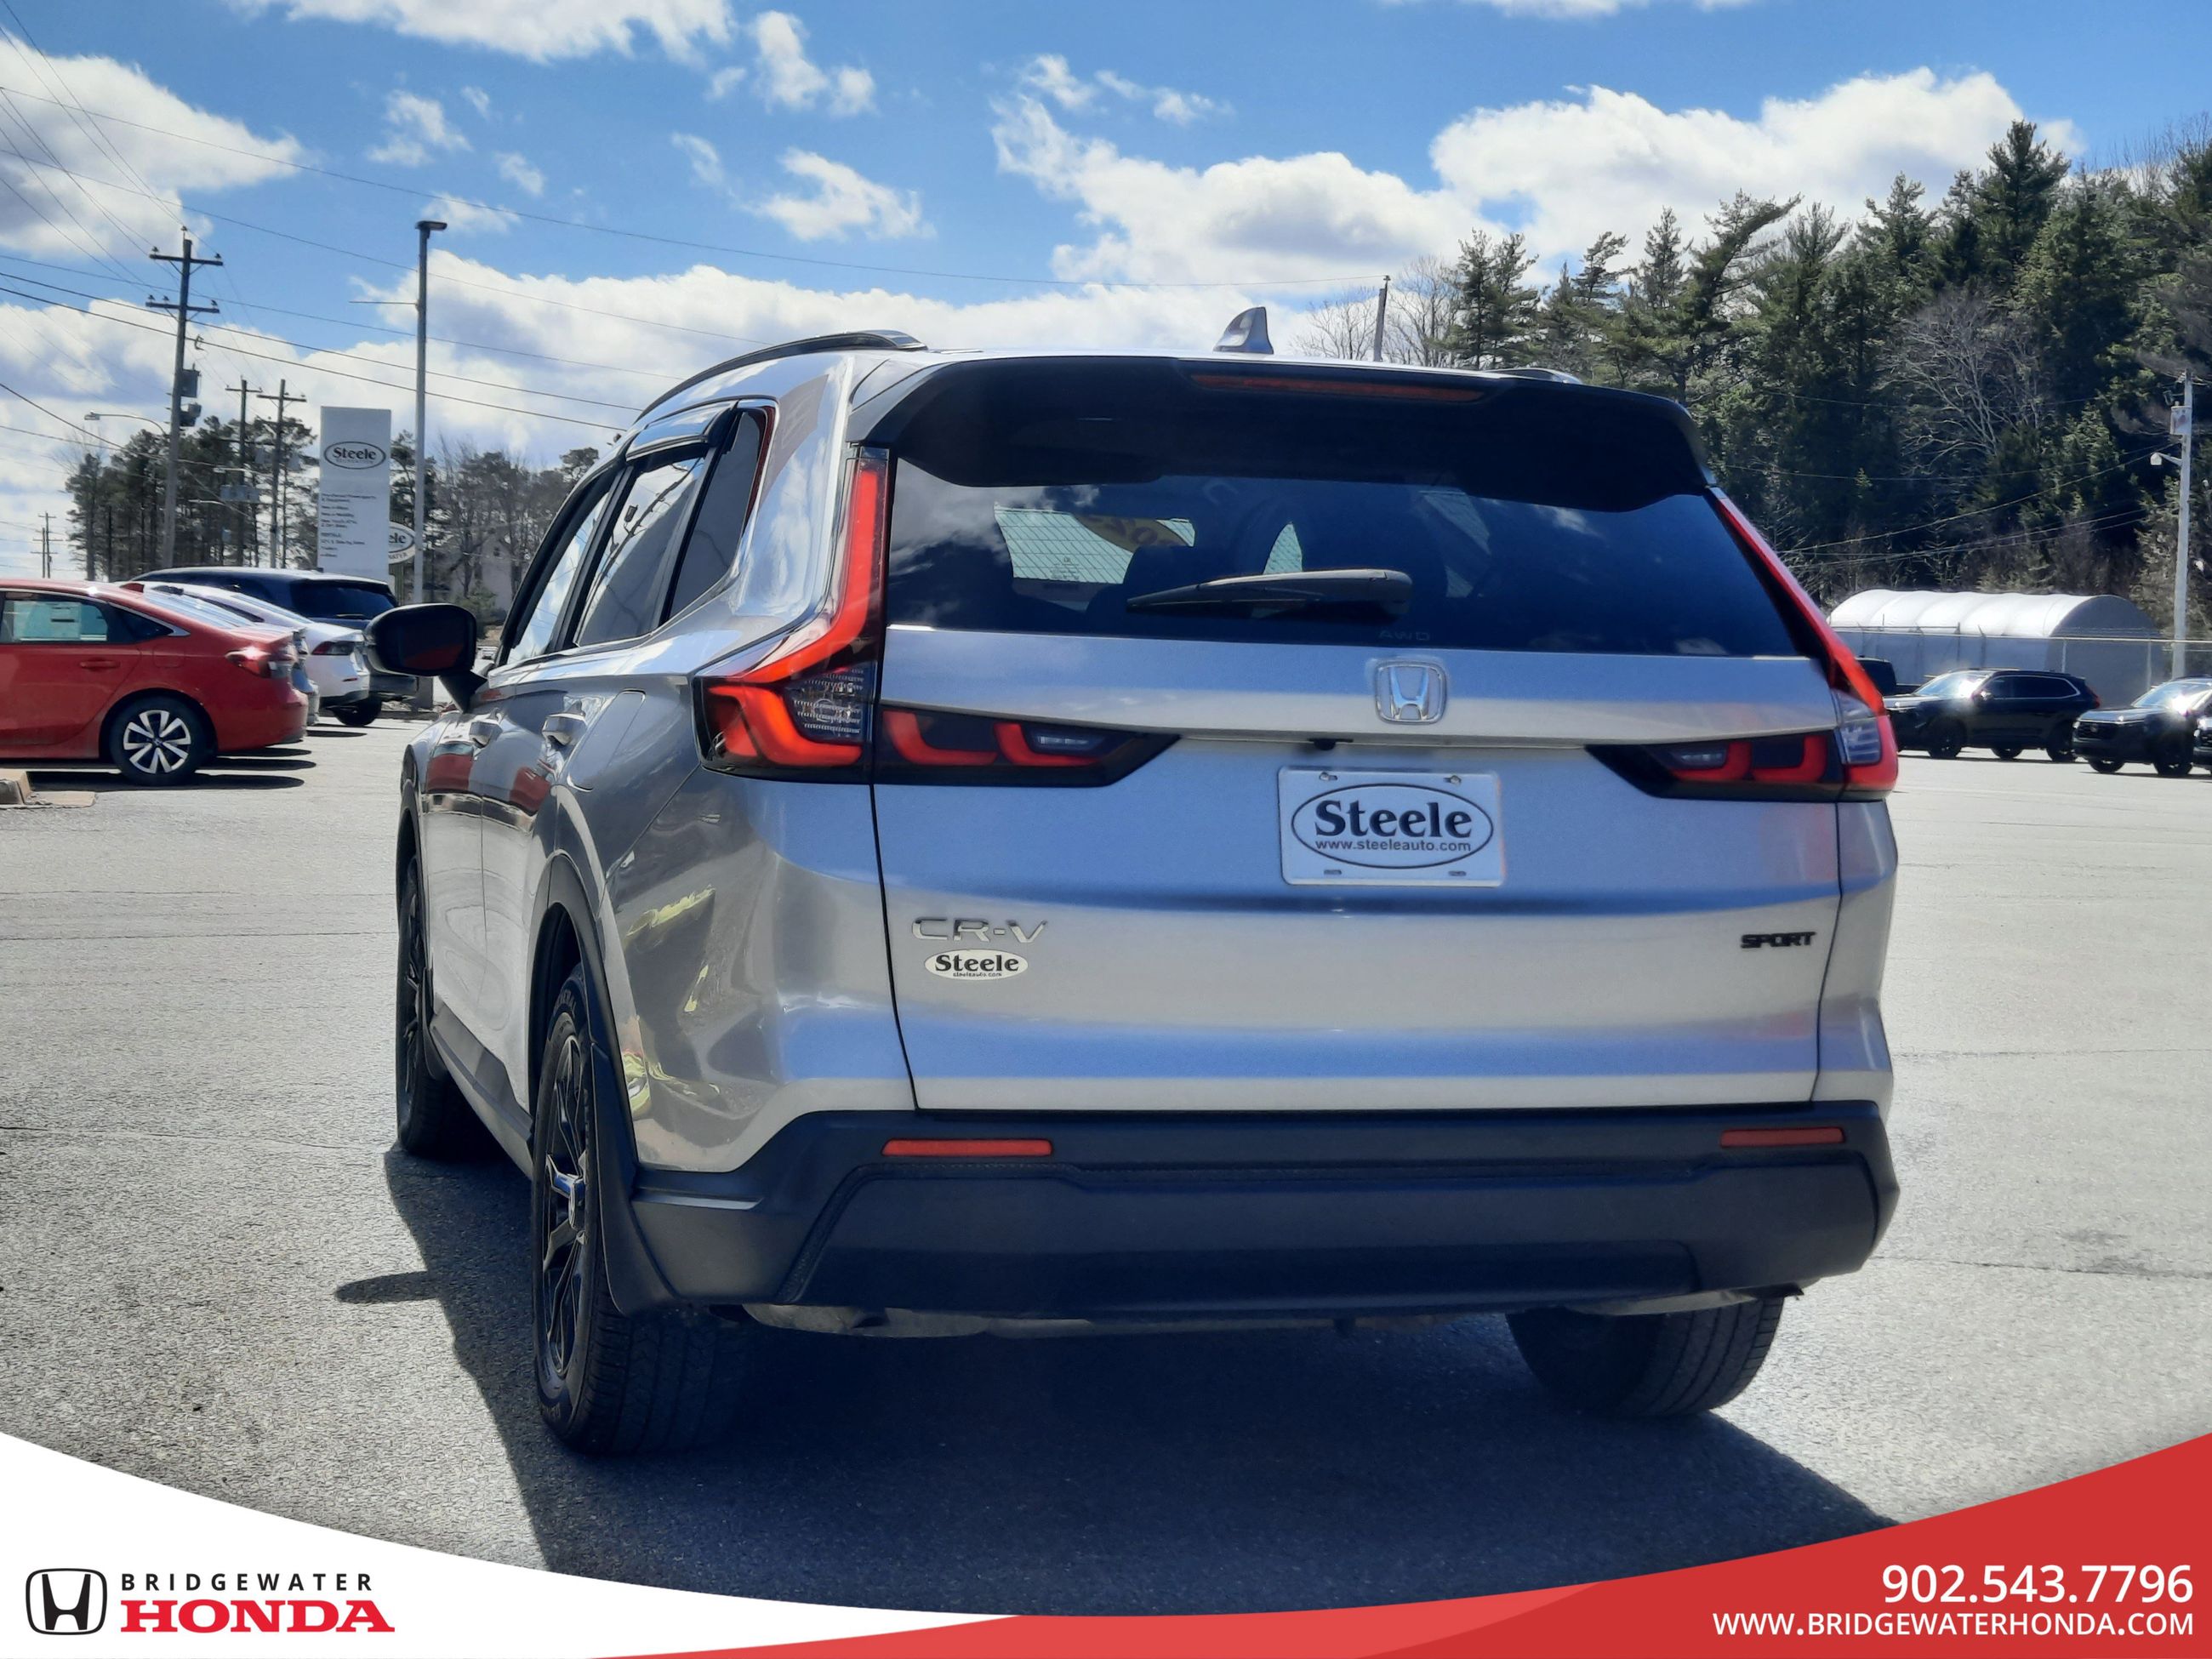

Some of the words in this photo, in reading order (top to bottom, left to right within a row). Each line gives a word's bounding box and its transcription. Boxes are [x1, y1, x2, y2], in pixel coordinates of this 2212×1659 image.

[333, 447, 377, 460] Steele
[388, 533, 407, 544] ele
[1314, 800, 1472, 838] Steele
[1315, 838, 1471, 852] www.steeleauto.com
[912, 916, 1048, 944] CR-V
[1741, 931, 1816, 949] SPORT
[935, 954, 1019, 972] Steele
